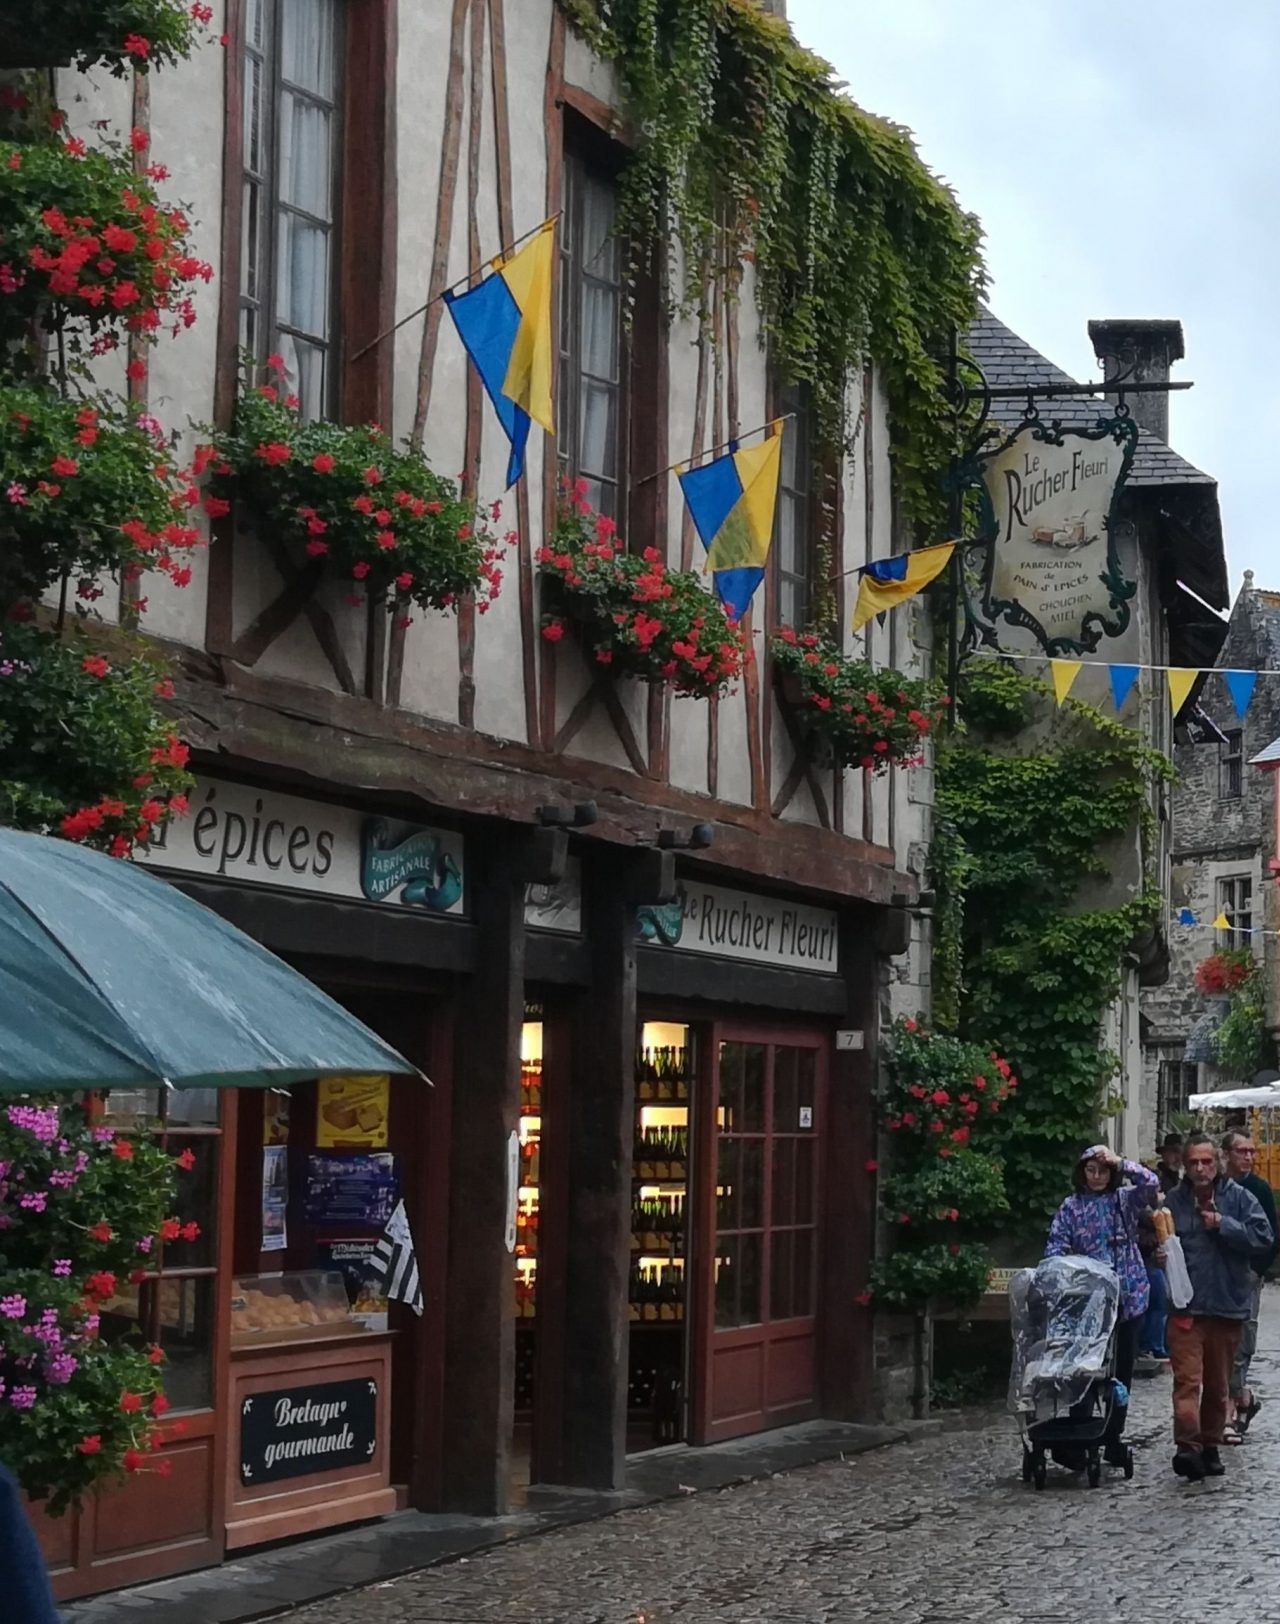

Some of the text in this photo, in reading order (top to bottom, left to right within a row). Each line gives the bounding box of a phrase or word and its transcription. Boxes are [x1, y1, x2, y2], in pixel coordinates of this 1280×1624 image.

[1024, 452, 1040, 477] Le
[1003, 449, 1109, 543] Rucher Fleuri
[1020, 561, 1083, 569] FABRICATION
[1013, 574, 1038, 590] PAIN
[1039, 594, 1092, 612] CHOUCHEN
[1050, 610, 1075, 623] MIEL
[371, 856, 431, 893] ARTISANALE
[699, 894, 774, 951] Rucher
[778, 910, 836, 962] Fleuri
[845, 1034, 854, 1046] 7
[275, 1398, 347, 1427] Bretagne
[265, 1423, 354, 1469] gourmande
